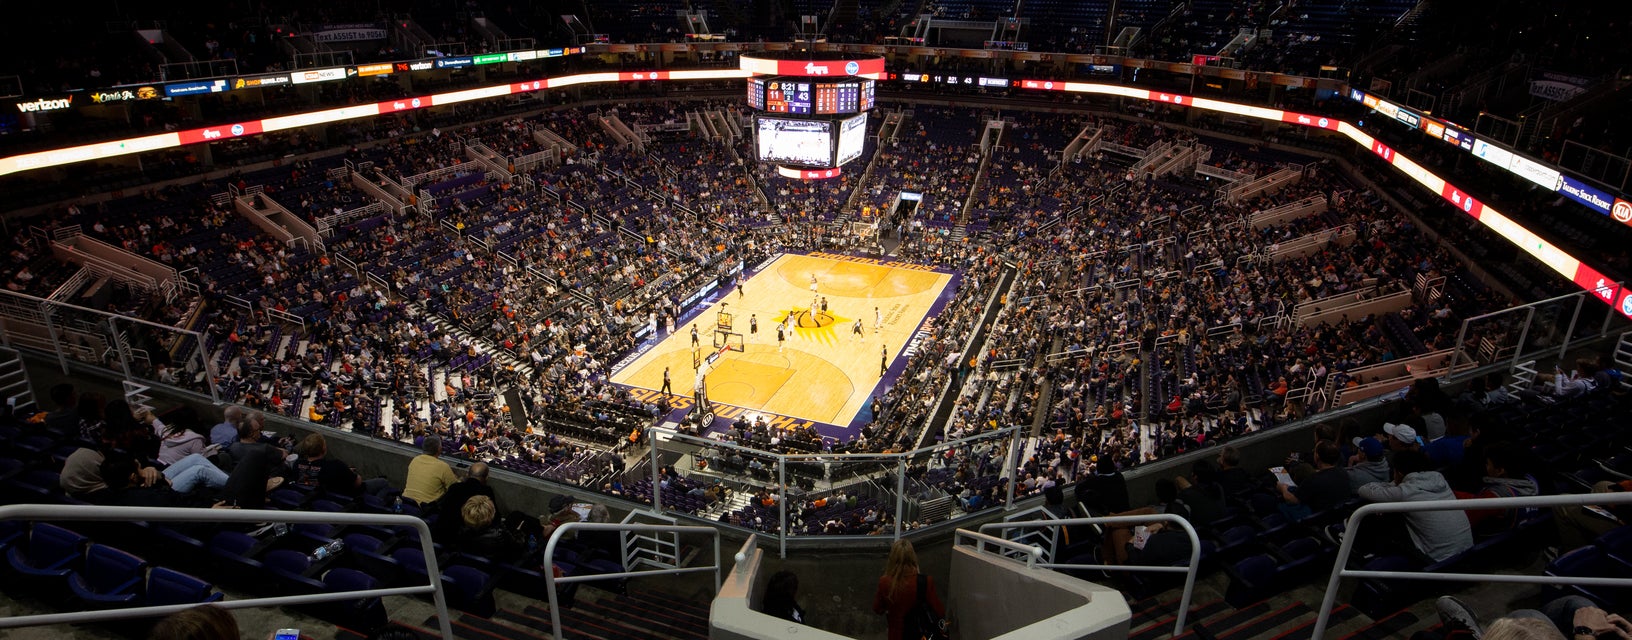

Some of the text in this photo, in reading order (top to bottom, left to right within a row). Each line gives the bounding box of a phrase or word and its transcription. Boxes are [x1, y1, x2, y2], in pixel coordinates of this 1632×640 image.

[315, 33, 332, 42] Text
[333, 31, 357, 41] ASSIST
[366, 30, 386, 38] 90561
[319, 71, 335, 79] NEWS
[781, 82, 796, 91] 8:21
[99, 91, 135, 103] Carl's Jr.
[770, 90, 779, 99] 11
[798, 92, 809, 101] 43
[16, 98, 69, 114] verizon
[1562, 181, 1611, 211] TALKING STICK RESORT
[1615, 204, 1629, 220] KIA
[808, 251, 938, 272] PHOENIX SUNS
[627, 387, 696, 411] SUNS
